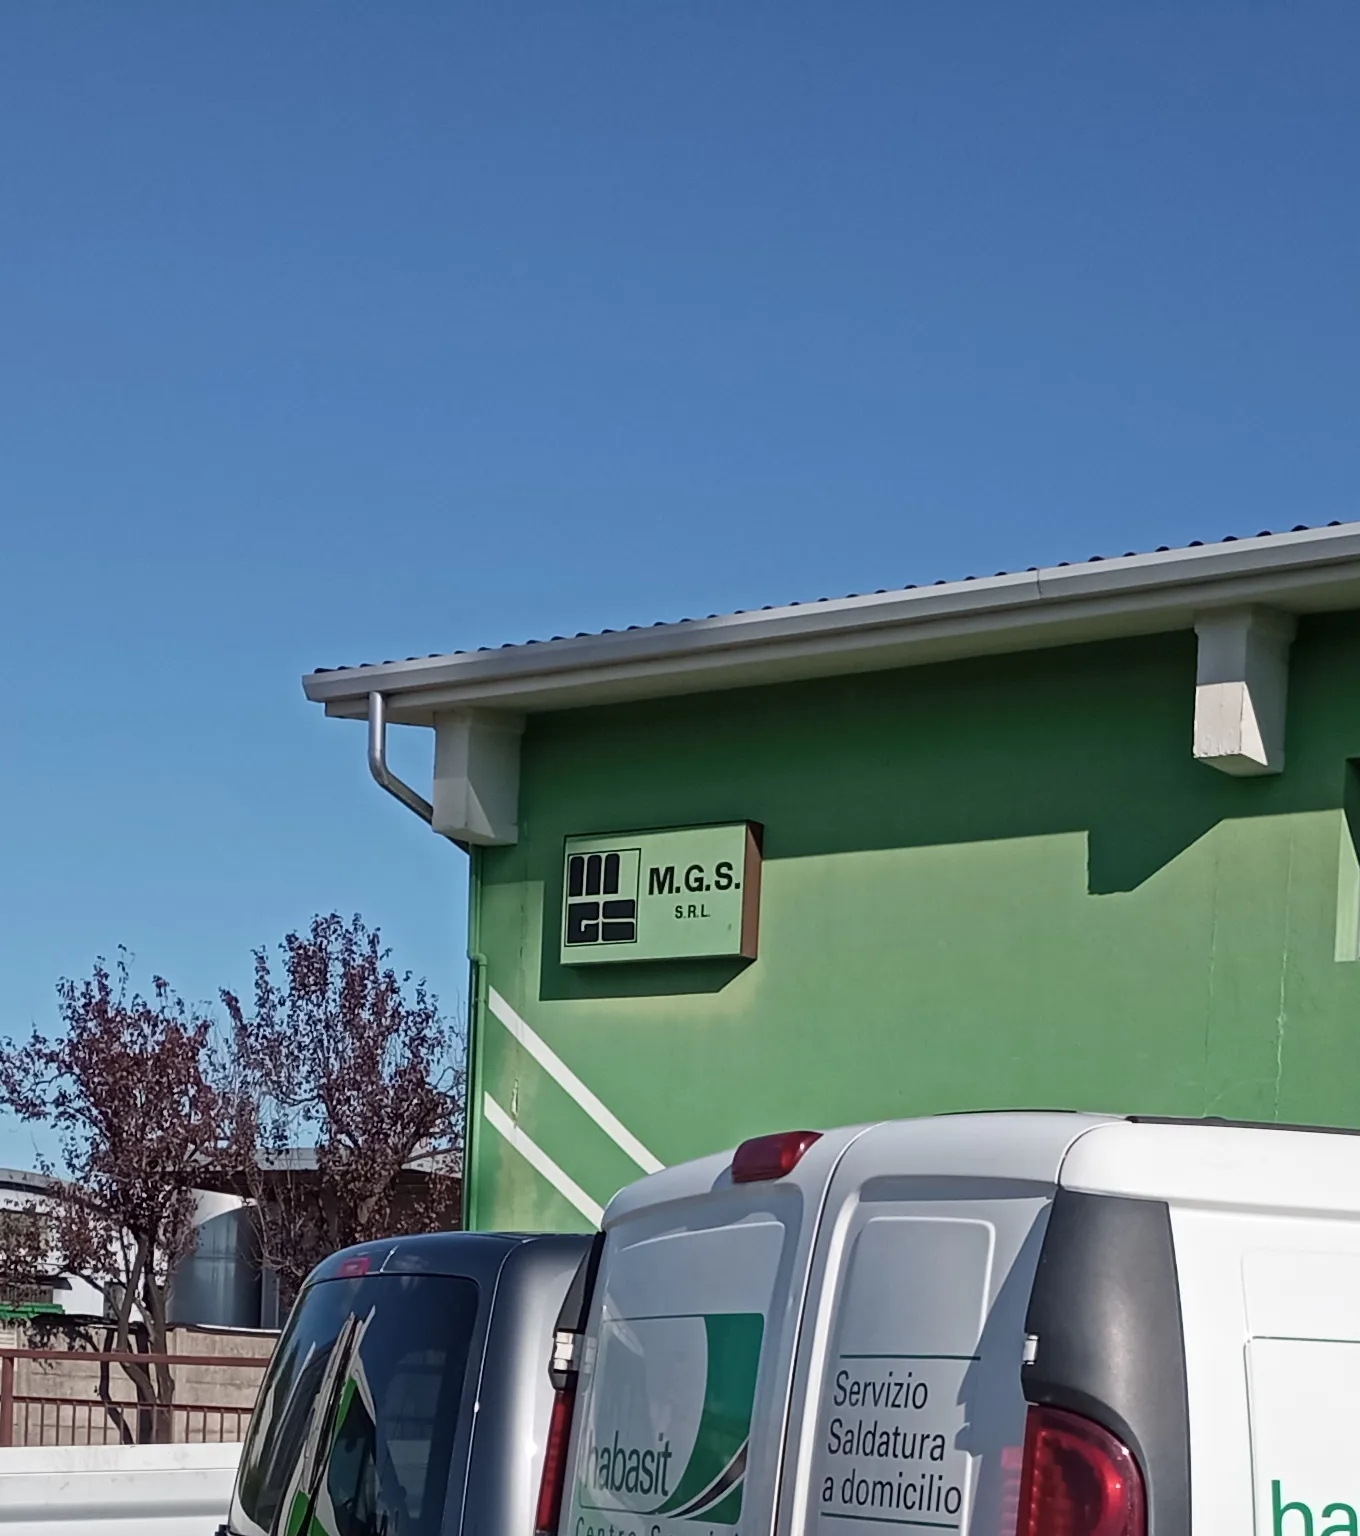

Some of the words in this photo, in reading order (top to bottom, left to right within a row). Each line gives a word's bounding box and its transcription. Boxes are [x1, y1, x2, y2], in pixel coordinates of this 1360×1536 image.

[648, 861, 741, 895] M.G.S.
[833, 1370, 928, 1410] Servizio
[827, 1418, 946, 1462] Saldatura
[822, 1475, 834, 1503] a
[841, 1468, 962, 1514] domicilio
